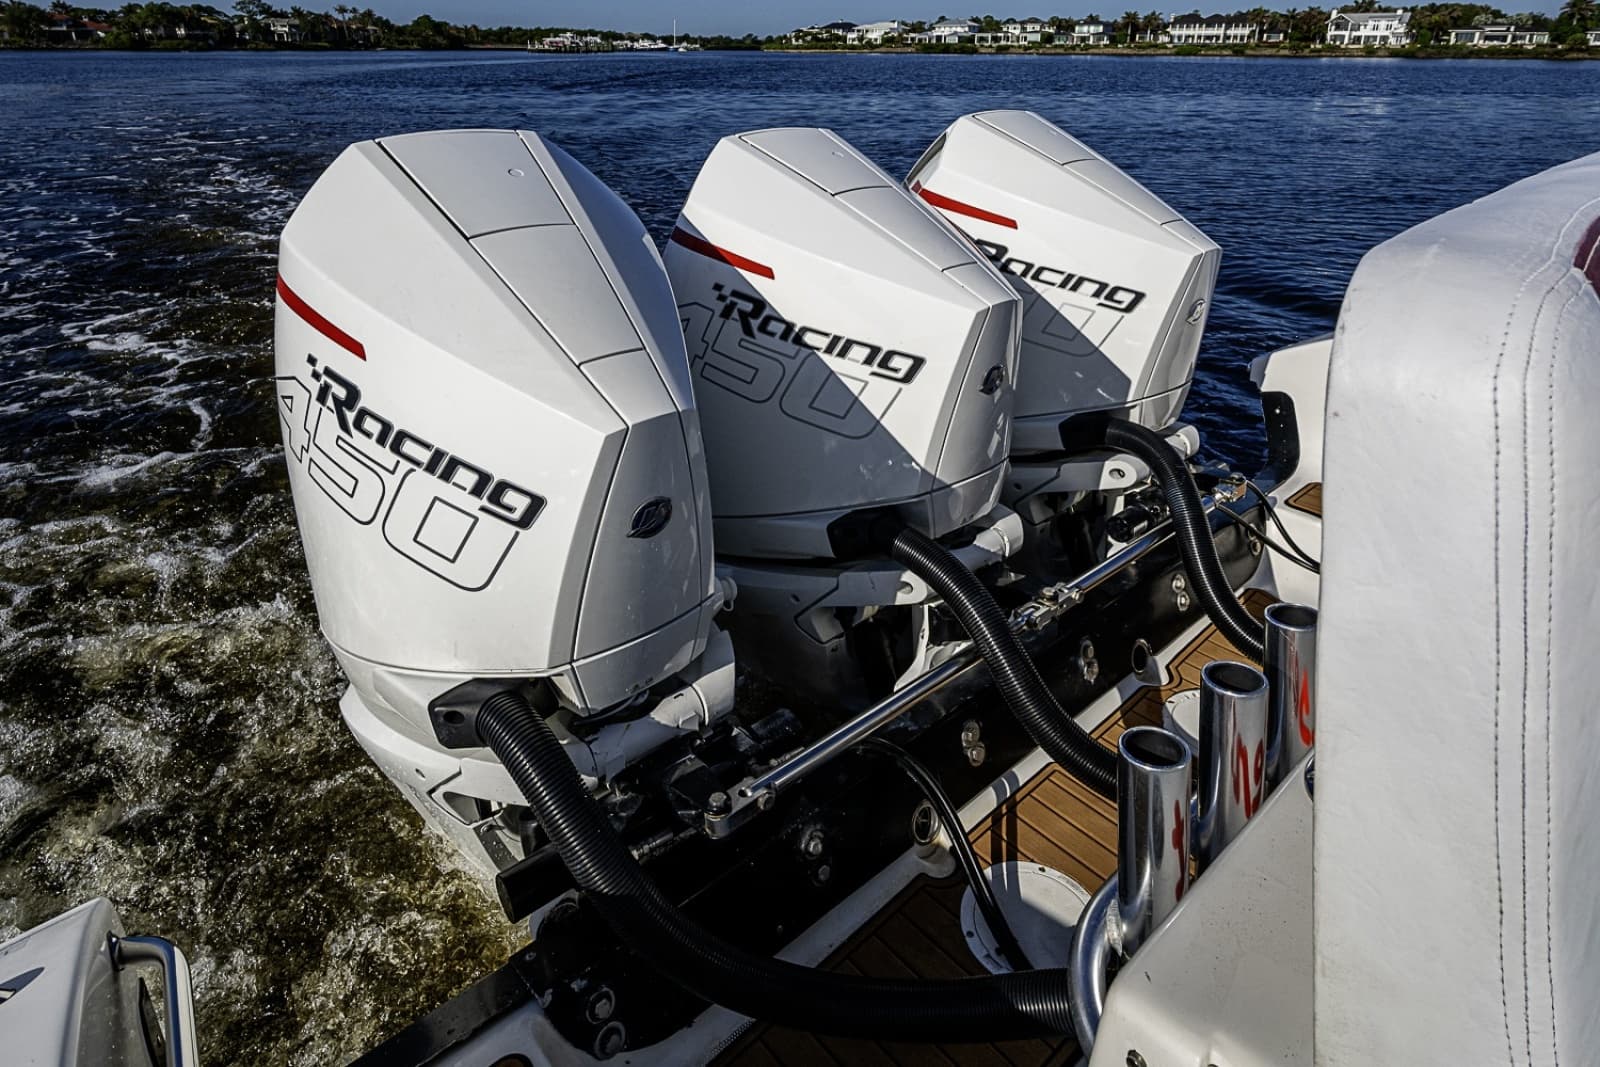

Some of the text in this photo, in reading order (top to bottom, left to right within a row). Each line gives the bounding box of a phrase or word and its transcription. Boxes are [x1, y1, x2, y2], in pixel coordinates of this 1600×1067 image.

[712, 282, 927, 385] Racing
[275, 375, 520, 592] 450
[307, 353, 547, 530] Racing
